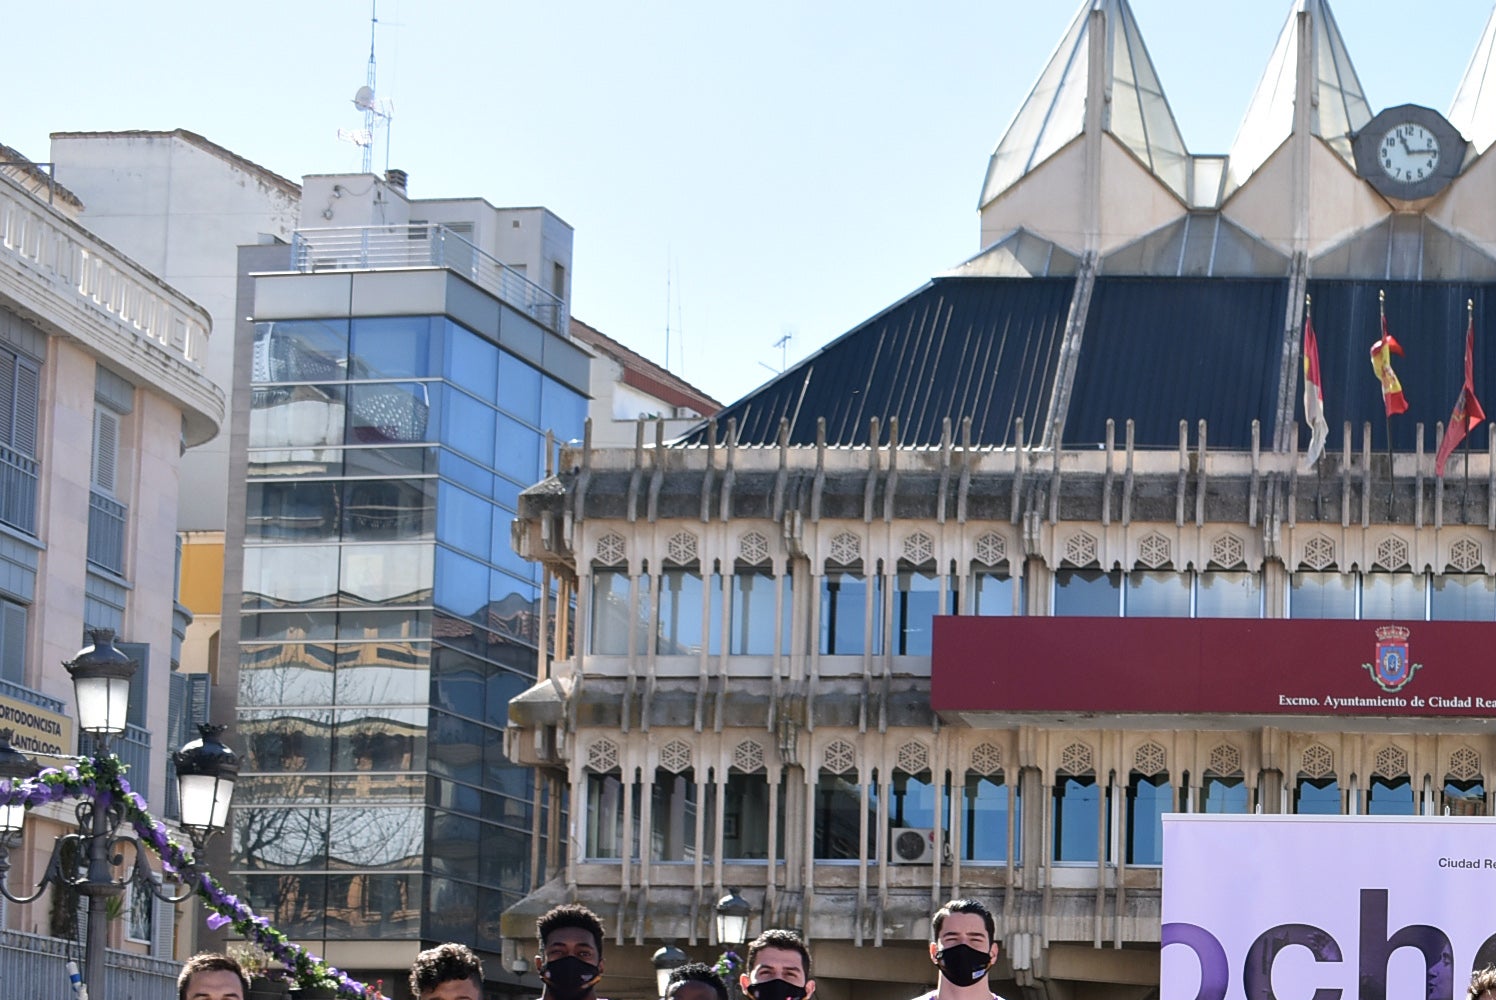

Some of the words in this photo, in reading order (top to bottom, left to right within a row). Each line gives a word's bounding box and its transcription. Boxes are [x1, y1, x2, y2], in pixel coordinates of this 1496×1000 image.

[1279, 695, 1319, 706] Excmo.
[1324, 696, 1407, 709] Ayuntamiento
[1410, 696, 1425, 707] de
[1429, 697, 1472, 708] Ciudad
[1438, 857, 1480, 870] Ciudad
